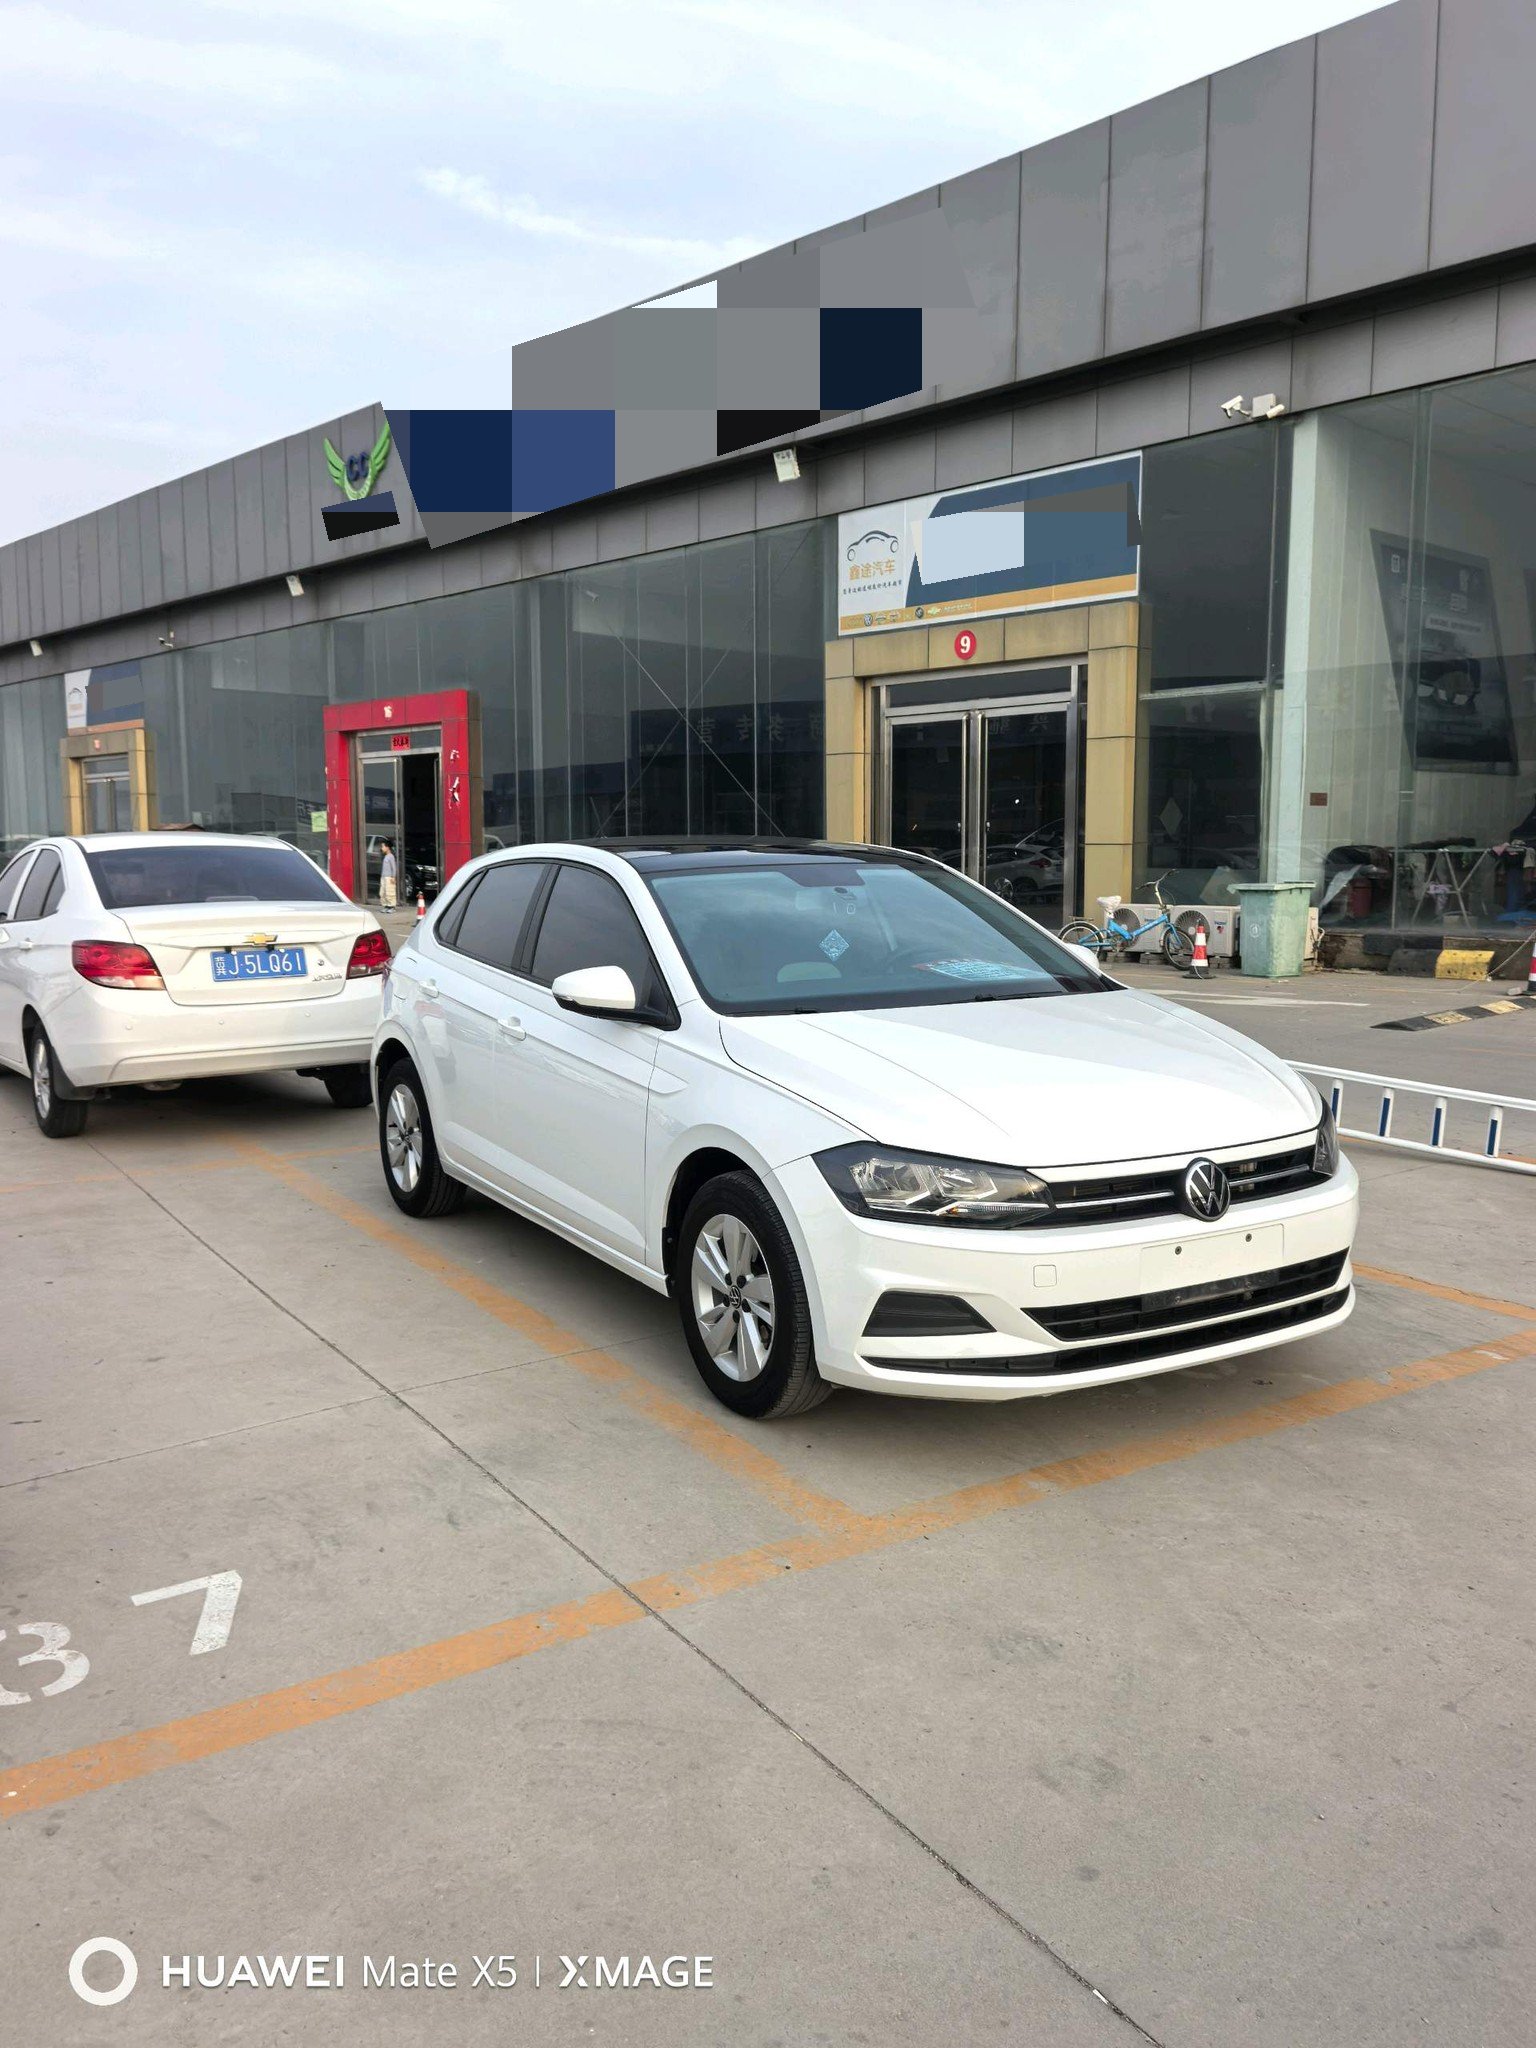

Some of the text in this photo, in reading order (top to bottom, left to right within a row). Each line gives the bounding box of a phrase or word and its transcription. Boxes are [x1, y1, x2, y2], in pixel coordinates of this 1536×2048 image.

[848, 558, 896, 581] 鑫途汽车
[960, 635, 971, 654] 9
